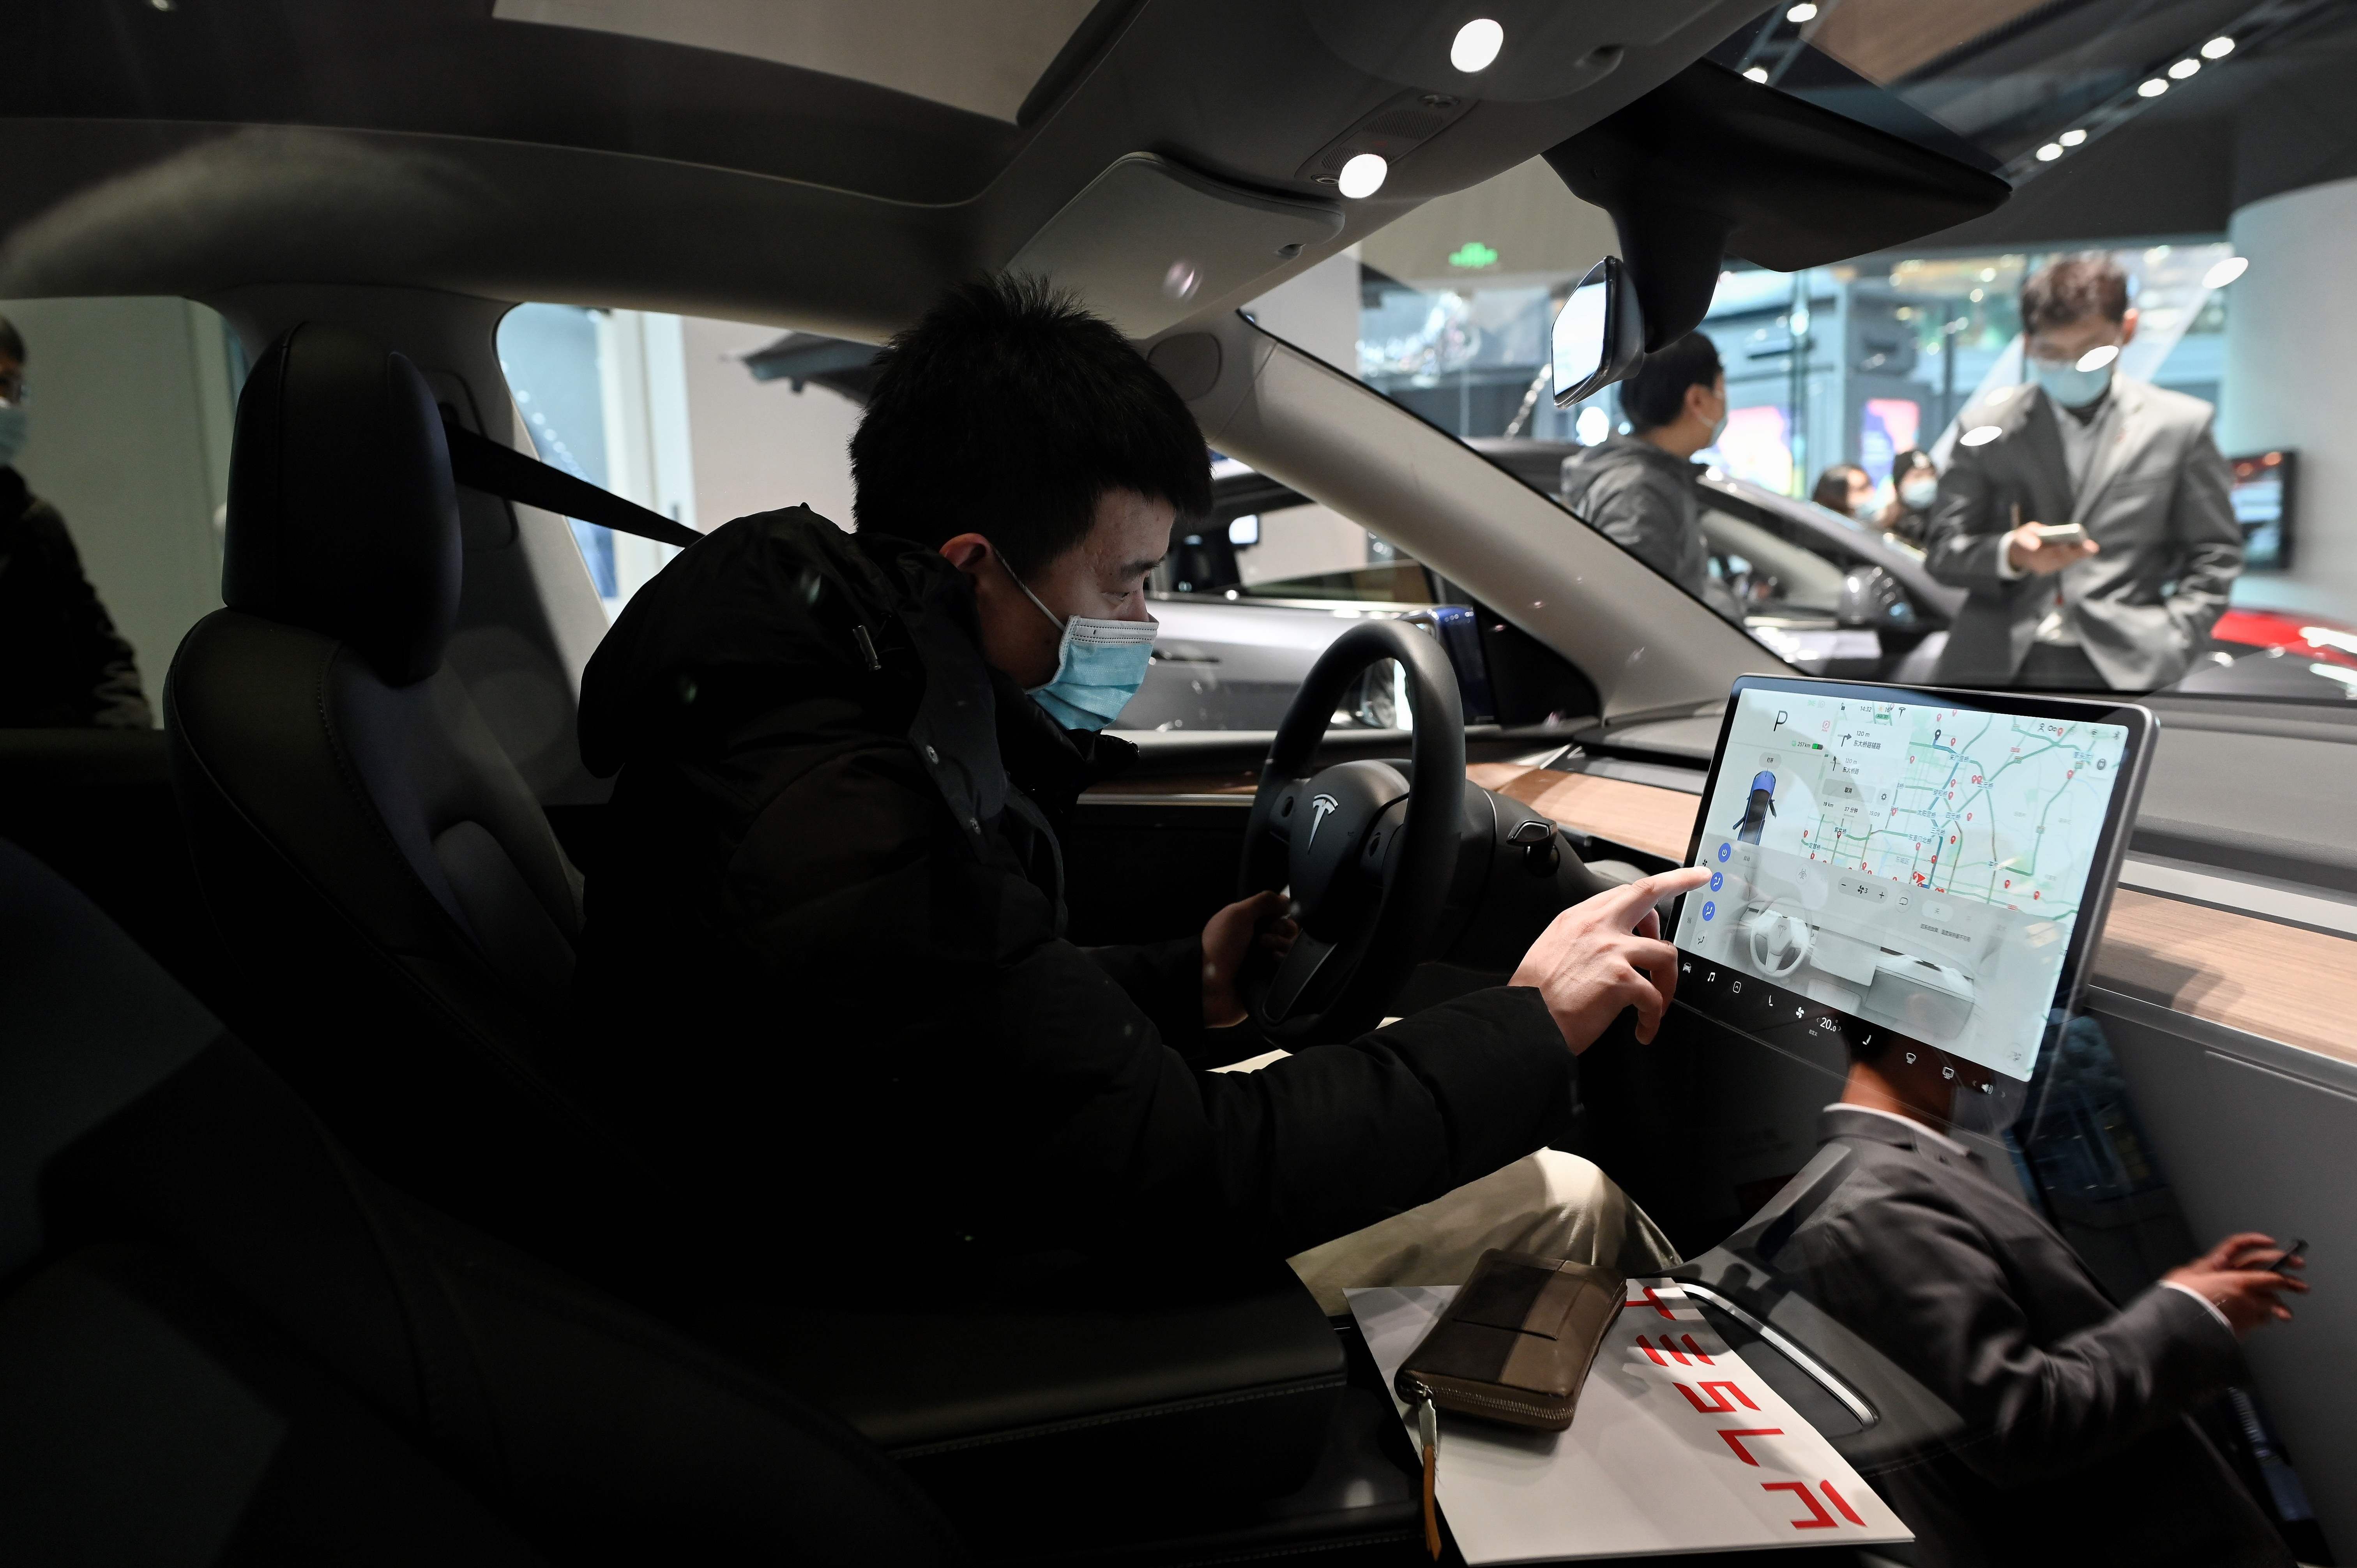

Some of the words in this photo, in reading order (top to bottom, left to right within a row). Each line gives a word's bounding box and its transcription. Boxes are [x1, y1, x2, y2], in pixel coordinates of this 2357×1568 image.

[1773, 710, 1788, 732] P
[1842, 766, 1859, 775] 东大桥路
[1624, 1286, 1868, 1529] TESLA
